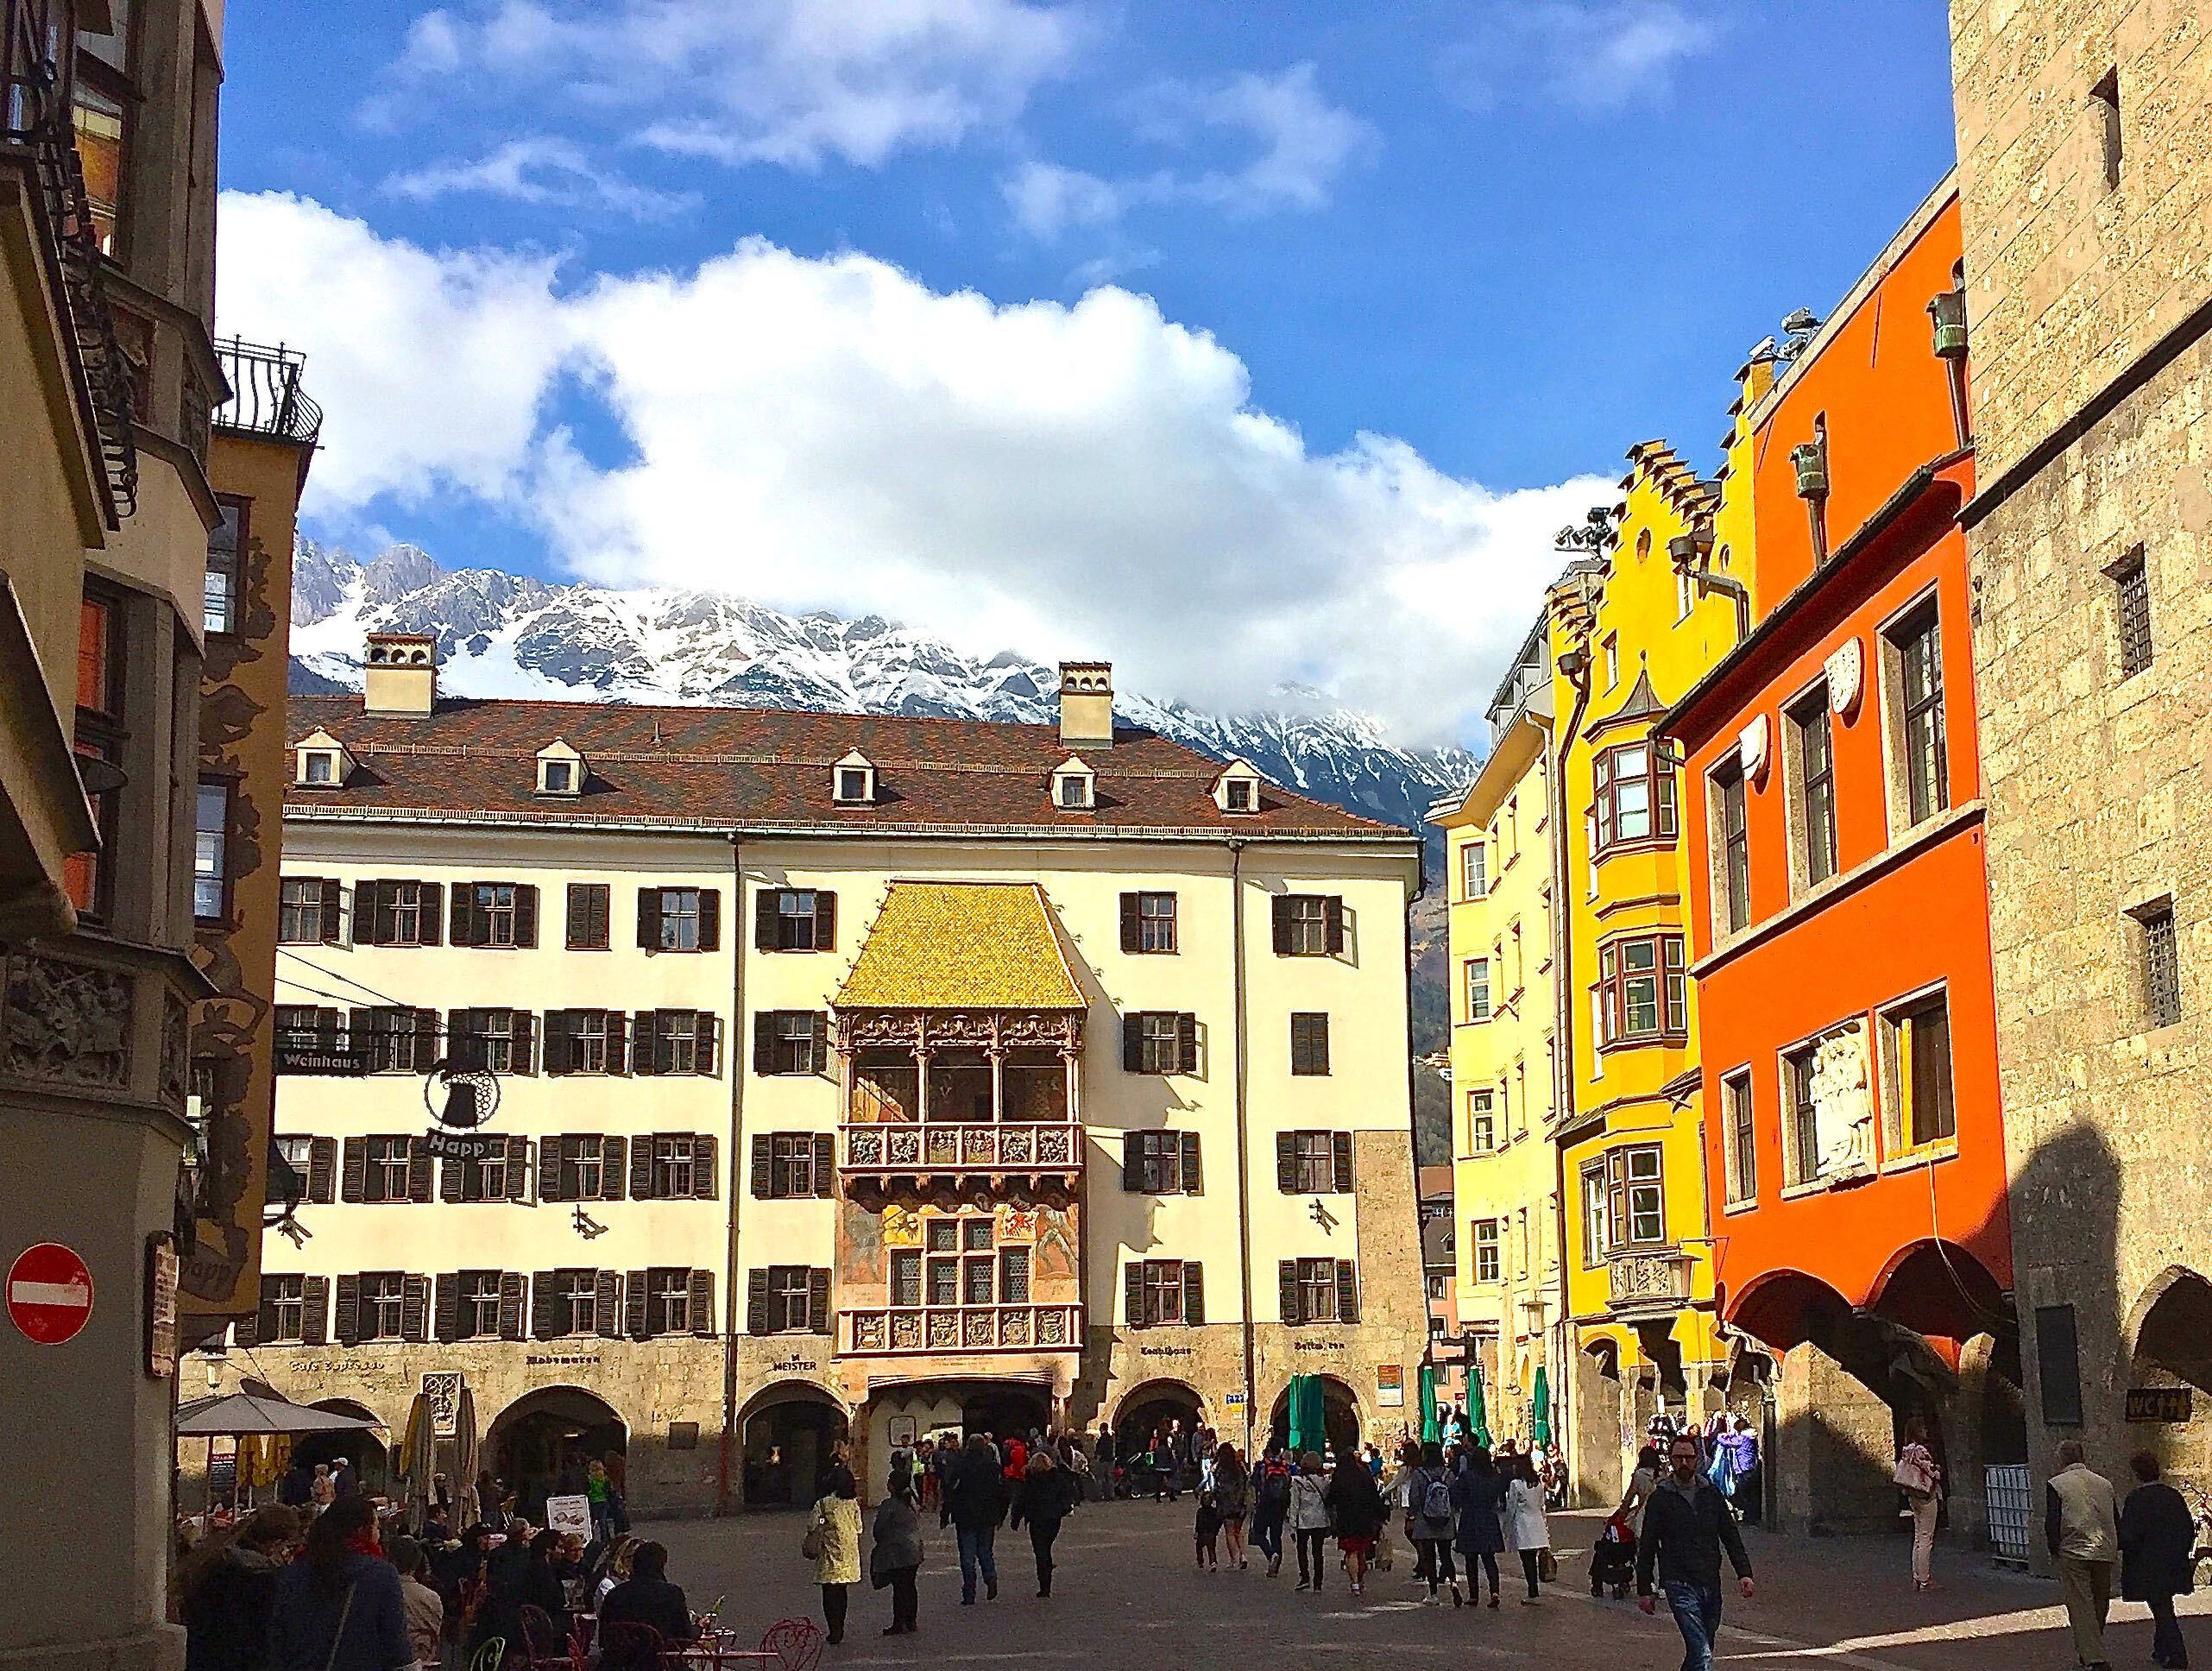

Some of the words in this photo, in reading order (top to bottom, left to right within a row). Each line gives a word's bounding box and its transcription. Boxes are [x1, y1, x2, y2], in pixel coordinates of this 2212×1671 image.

[283, 1052, 360, 1069] Weinhaus
[429, 1134, 484, 1157] Happ
[773, 1361, 817, 1371] MEISTER
[2127, 1396, 2156, 1416] WC
